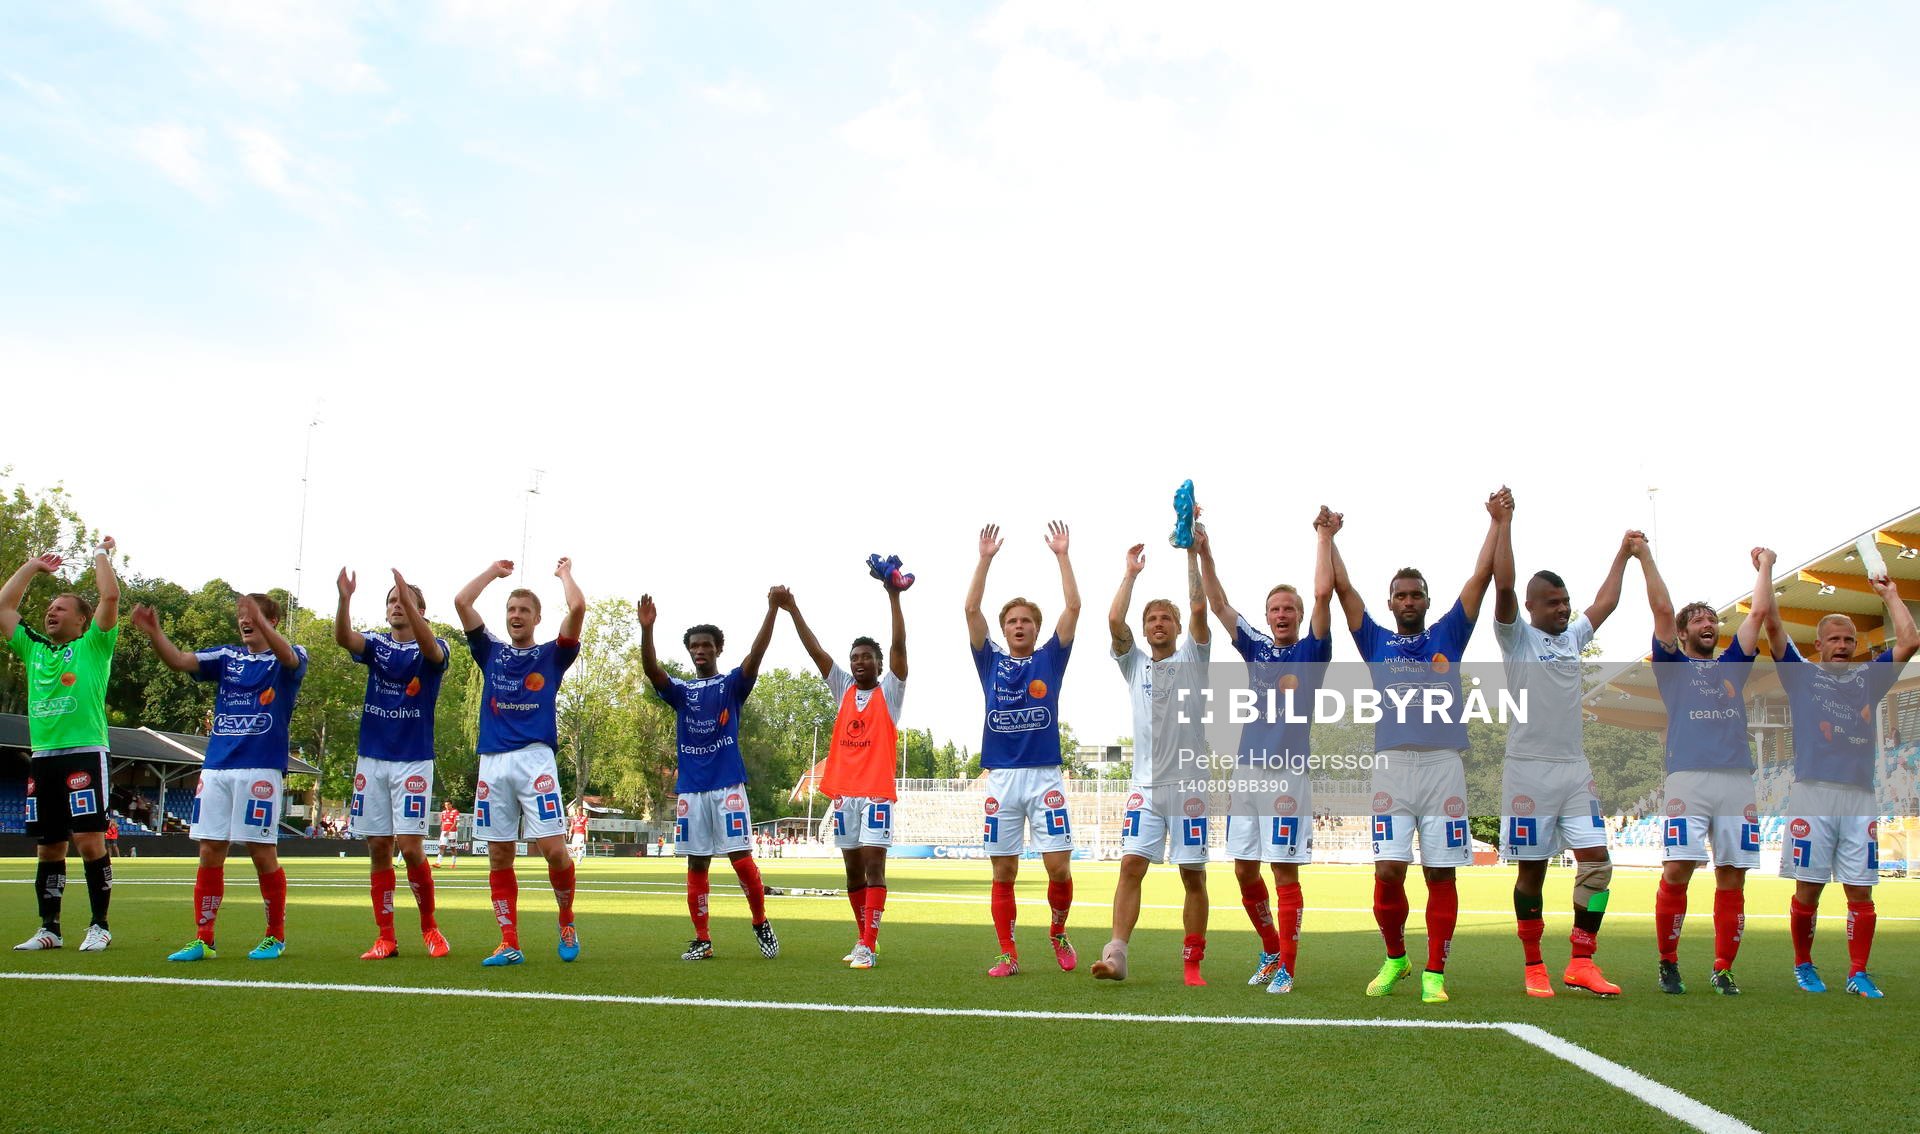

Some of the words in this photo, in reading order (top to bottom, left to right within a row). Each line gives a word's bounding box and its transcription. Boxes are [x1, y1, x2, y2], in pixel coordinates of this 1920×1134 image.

[365, 703, 420, 719] team:olivia
[999, 709, 1045, 725] EWG
[680, 735, 734, 755] team:olivia
[407, 780, 424, 789] mix
[536, 779, 552, 789] mix
[1047, 795, 1063, 804] mix
[1373, 798, 1388, 807] mix
[1277, 801, 1294, 810] mix
[1447, 803, 1463, 812] mix
[1514, 802, 1532, 810] mix
[1509, 846, 1518, 855] 11
